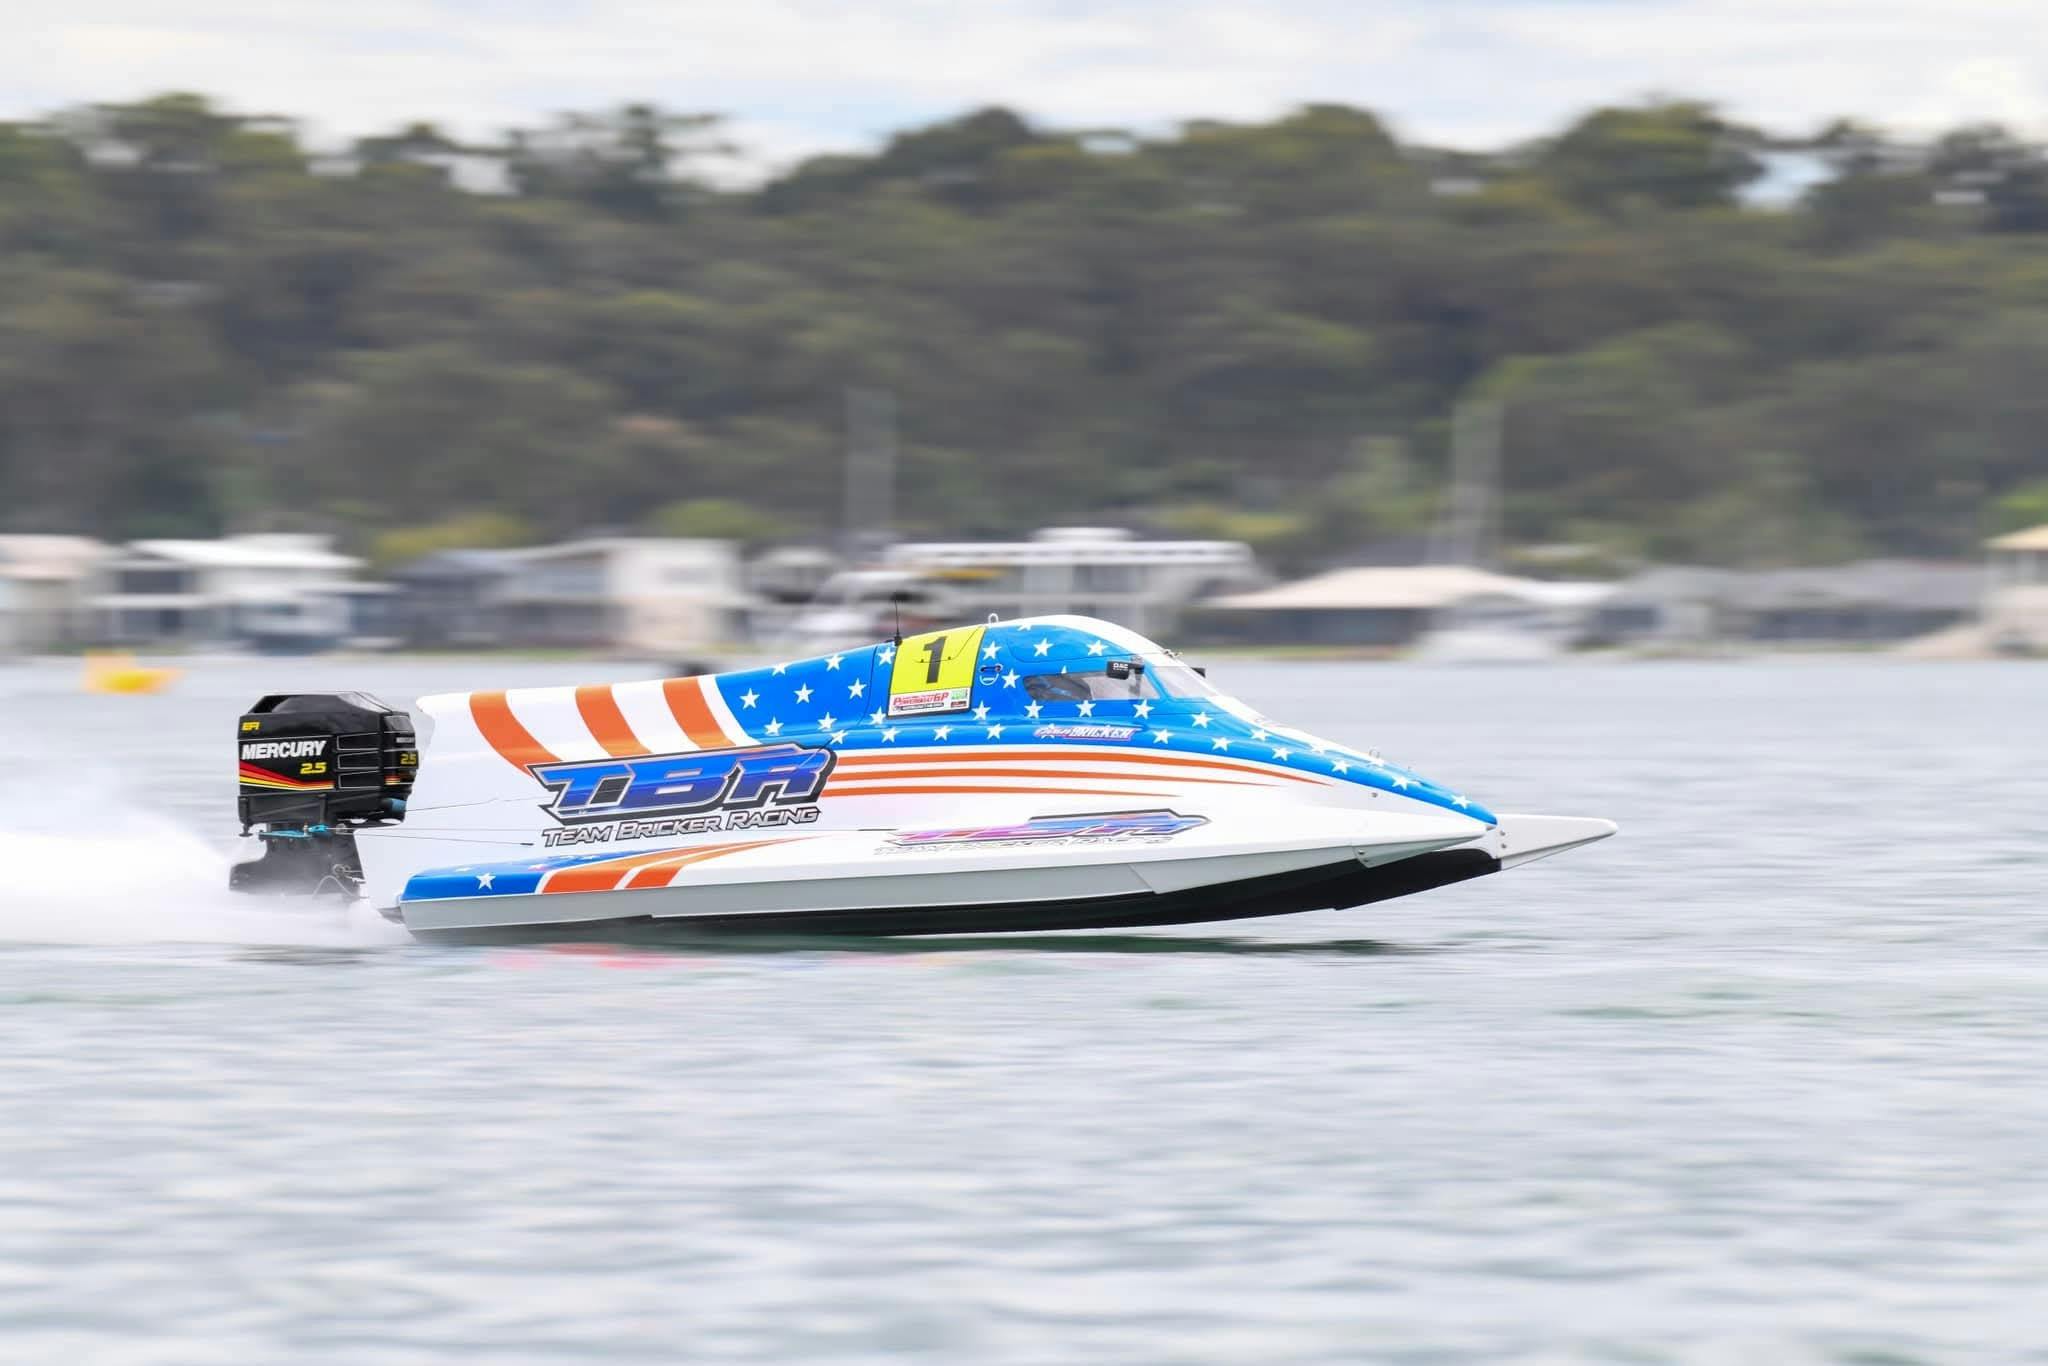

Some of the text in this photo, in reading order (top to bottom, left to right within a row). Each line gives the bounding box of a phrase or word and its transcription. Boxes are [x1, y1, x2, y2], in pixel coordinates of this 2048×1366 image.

[923, 636, 947, 684] 1
[241, 721, 260, 731] EFI
[241, 740, 326, 760] MERCURY
[300, 762, 327, 775] 2.5
[528, 745, 834, 822] TBR
[542, 806, 821, 847] TEAM BRICKER RACING
